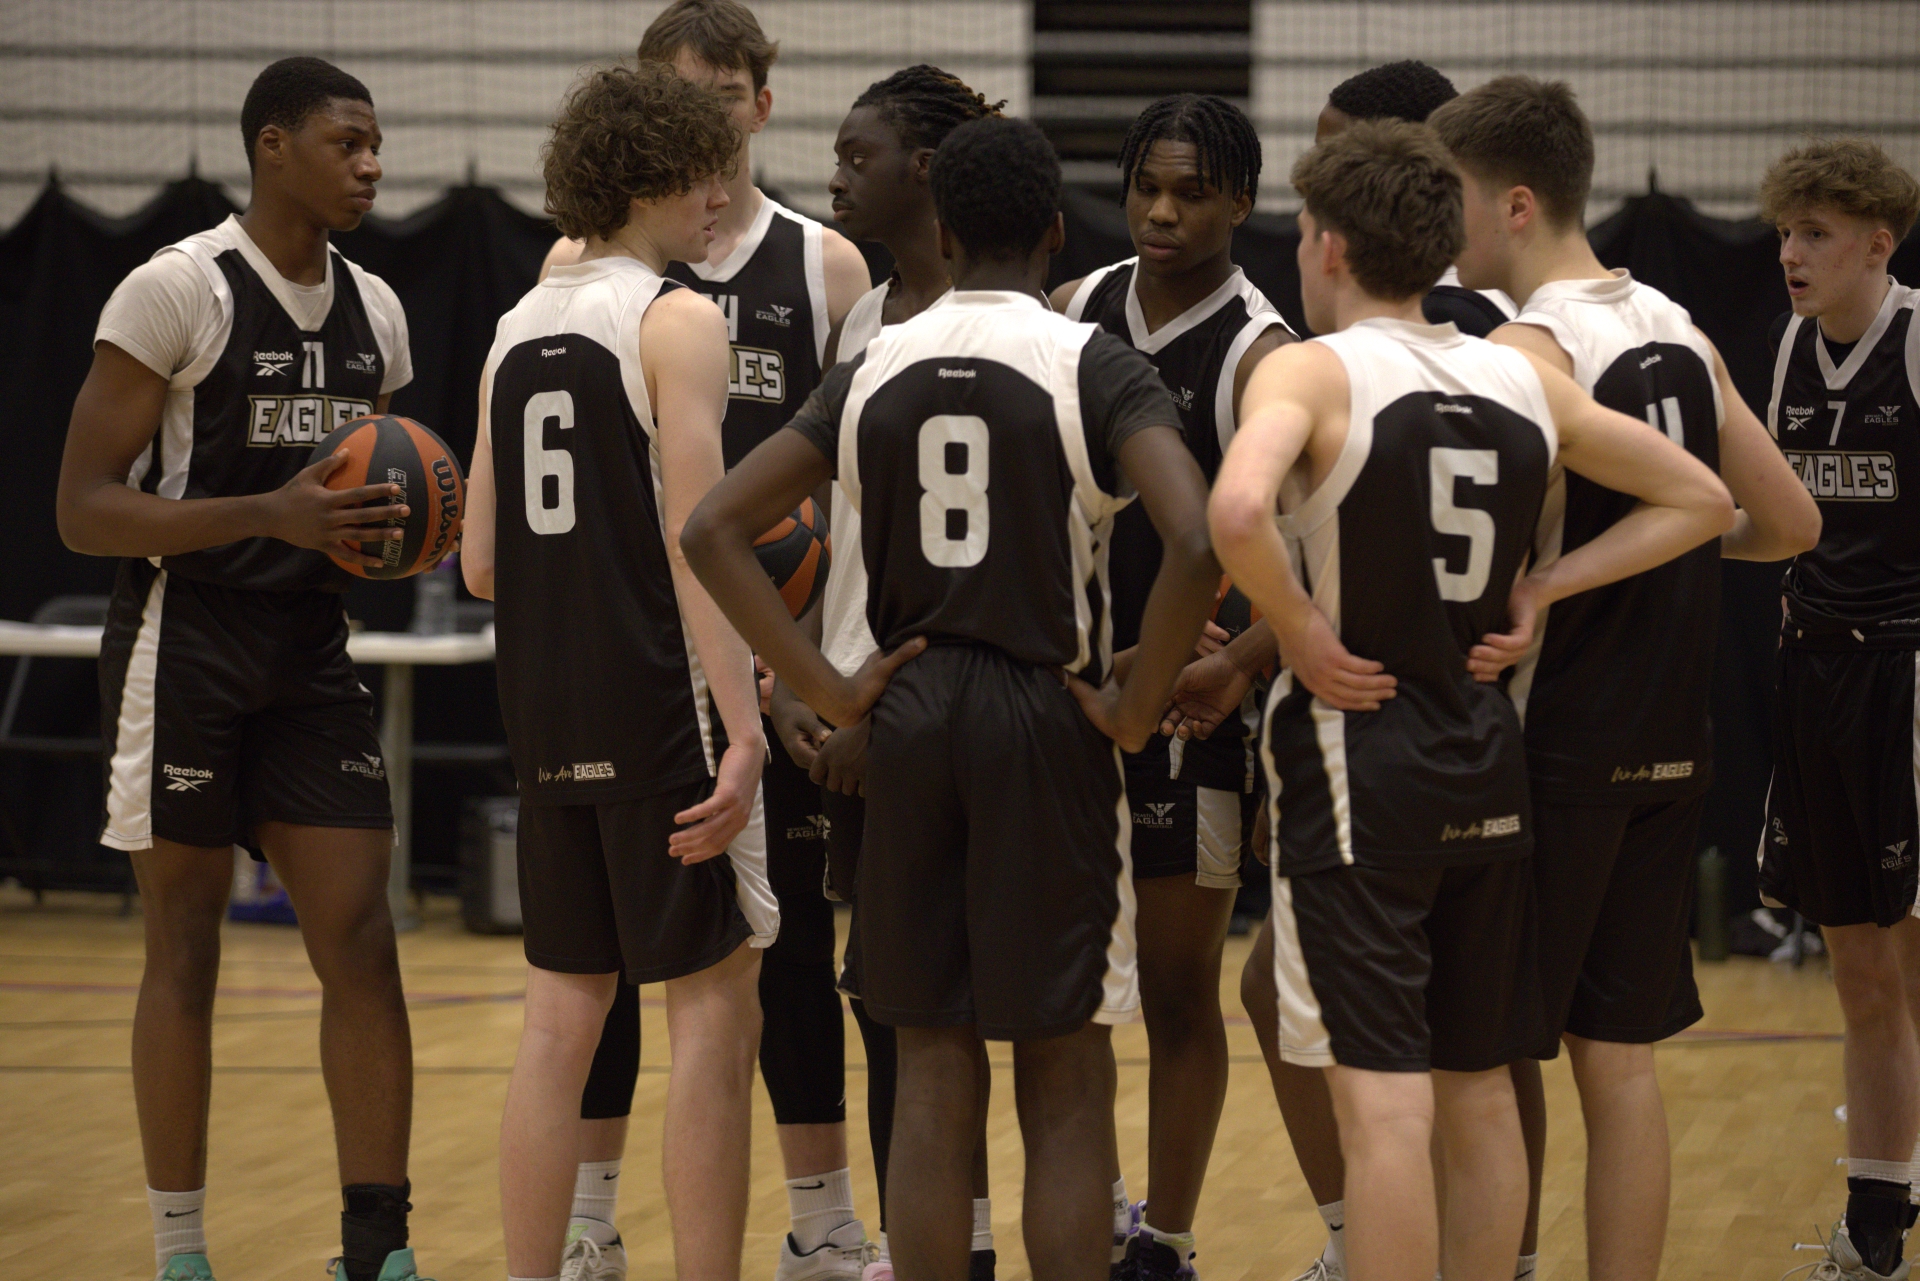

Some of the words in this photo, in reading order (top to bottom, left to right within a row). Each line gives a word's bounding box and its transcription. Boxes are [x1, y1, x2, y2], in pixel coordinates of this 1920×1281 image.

[700, 293, 739, 342] 4
[756, 312, 791, 325] EAGLES
[254, 351, 294, 362] Reebok
[302, 341, 325, 389] 11
[1785, 405, 1814, 417] Reebok
[1864, 416, 1899, 424] EAGLES
[1827, 400, 1847, 446] 7
[524, 390, 576, 535] 6
[918, 414, 990, 568] 8
[1429, 446, 1498, 602] 5
[163, 763, 213, 779] Reebok
[341, 763, 385, 778] EAGLES
[574, 762, 615, 780] EAGLES
[1652, 762, 1694, 780] EAGLES
[1482, 815, 1521, 838] EAGLES
